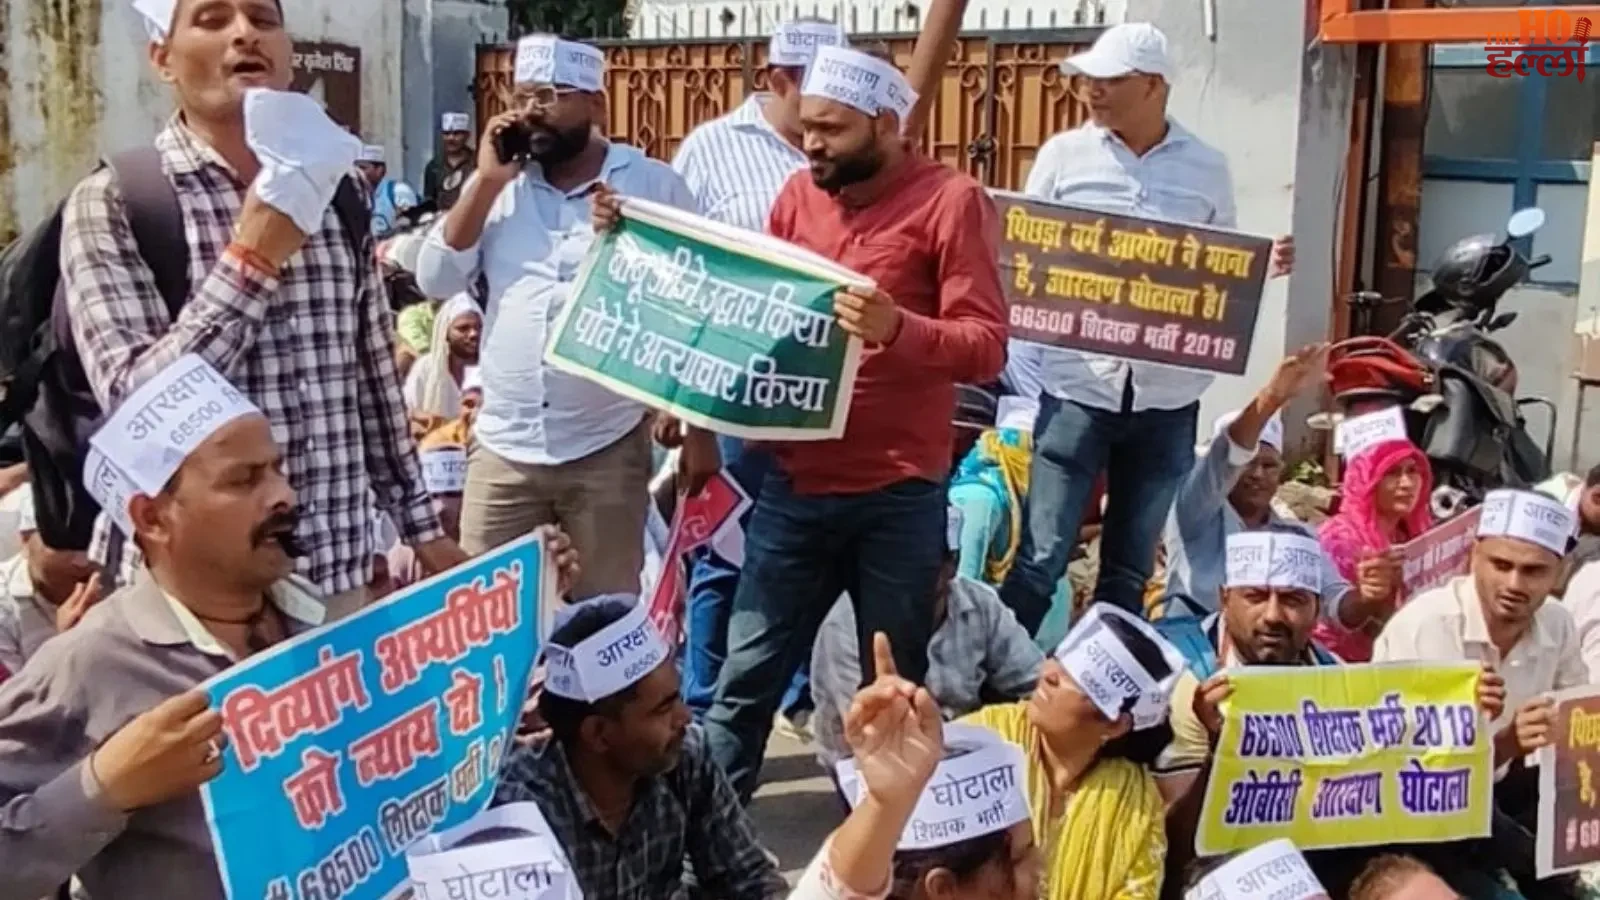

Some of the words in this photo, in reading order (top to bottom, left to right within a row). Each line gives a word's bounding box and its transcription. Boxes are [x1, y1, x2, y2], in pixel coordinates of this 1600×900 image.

[820, 57, 881, 90] आरक्षण
[1005, 205, 1066, 253] पिछड़ा
[1070, 217, 1107, 255] वर्ग
[1108, 227, 1178, 268] आयोग
[1182, 234, 1201, 270] ने
[1204, 245, 1256, 279] माना
[758, 280, 835, 348] किया
[1045, 265, 1125, 305] आरक्षण
[1128, 272, 1200, 317] घोटाला
[574, 296, 622, 354] पोते
[617, 308, 641, 360] ने
[633, 330, 745, 403] अत्याचार
[742, 352, 829, 412] किया
[1009, 304, 1074, 336] 68500
[1080, 306, 1140, 344] शिक्षक
[1144, 320, 1183, 353] भर्ती
[1184, 333, 1237, 361] 2018
[126, 364, 217, 441] आरक्षण
[169, 400, 224, 447] 68500
[1086, 640, 1143, 699] आरक्षण
[221, 645, 372, 773] दिव्यांग
[1240, 713, 1305, 757] 68500
[1302, 700, 1365, 756] शिक्षक
[1367, 694, 1407, 750] भर्ती
[283, 745, 346, 831] को
[349, 698, 442, 786] न्याय
[443, 666, 485, 736] दो
[929, 763, 1016, 807] घोटाला
[1225, 769, 1302, 825] ओबीसी
[1312, 771, 1383, 820] आरक्षण
[1399, 758, 1470, 813] घोटाला
[297, 824, 385, 900] 68500
[378, 775, 451, 859] शिक्षक
[451, 735, 487, 802] भर्ती
[912, 815, 967, 842] शिक्षक
[976, 799, 1010, 827] भर्ती
[441, 862, 553, 900] घोटाला
[1235, 852, 1305, 894] आरक्षण
